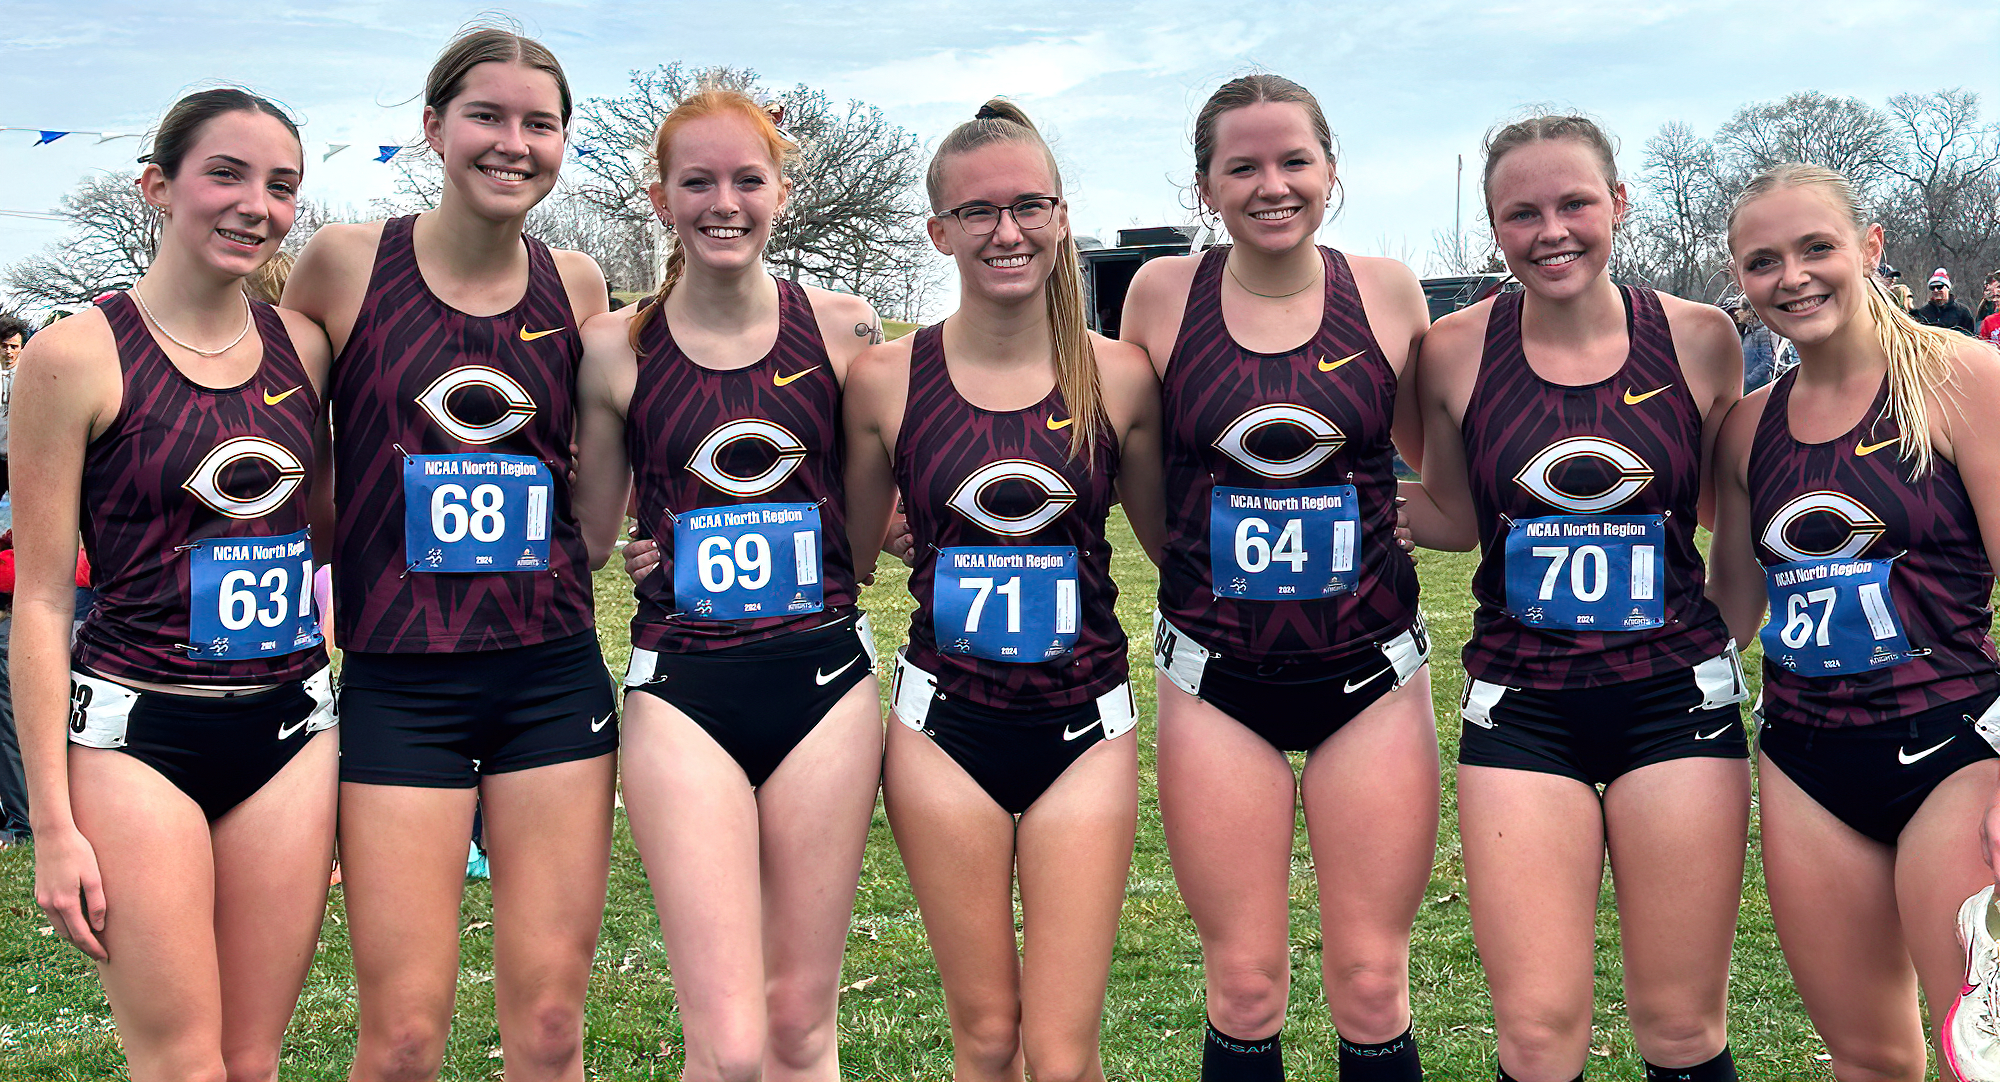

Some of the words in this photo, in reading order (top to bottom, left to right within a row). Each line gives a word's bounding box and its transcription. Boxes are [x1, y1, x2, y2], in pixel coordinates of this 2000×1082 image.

[425, 461, 459, 475] NCAA
[462, 461, 498, 475] North
[501, 461, 537, 477] Region
[1230, 494, 1262, 509] NCAA
[1264, 497, 1299, 511] North
[1302, 496, 1342, 511] Region
[431, 483, 506, 543] 68
[690, 514, 722, 530] NCAA
[724, 511, 760, 526] North
[762, 509, 803, 523] Region
[1526, 523, 1560, 537] NCAA
[1563, 523, 1600, 536] North
[1603, 523, 1646, 537] Region
[213, 546, 250, 561] NCAA
[252, 543, 286, 560] North
[1234, 517, 1308, 573] 64
[475, 556, 493, 565] 2024
[697, 532, 772, 593] 69
[954, 554, 986, 568] NCAA
[988, 554, 1023, 568] North
[1026, 554, 1064, 569] Region
[1532, 545, 1609, 602] 70
[1774, 571, 1797, 587] NCAA
[1796, 563, 1828, 582] North
[1829, 561, 1873, 577] Region
[1278, 586, 1295, 594] 2024
[218, 567, 289, 631] 63
[744, 603, 762, 612] 2024
[959, 576, 1021, 633] 71
[1576, 615, 1595, 624] 2024
[1780, 586, 1837, 649] 67
[260, 641, 276, 650] 2024
[1001, 647, 1018, 656] 2024
[1154, 617, 1178, 671] 64
[1823, 660, 1841, 668] 2024
